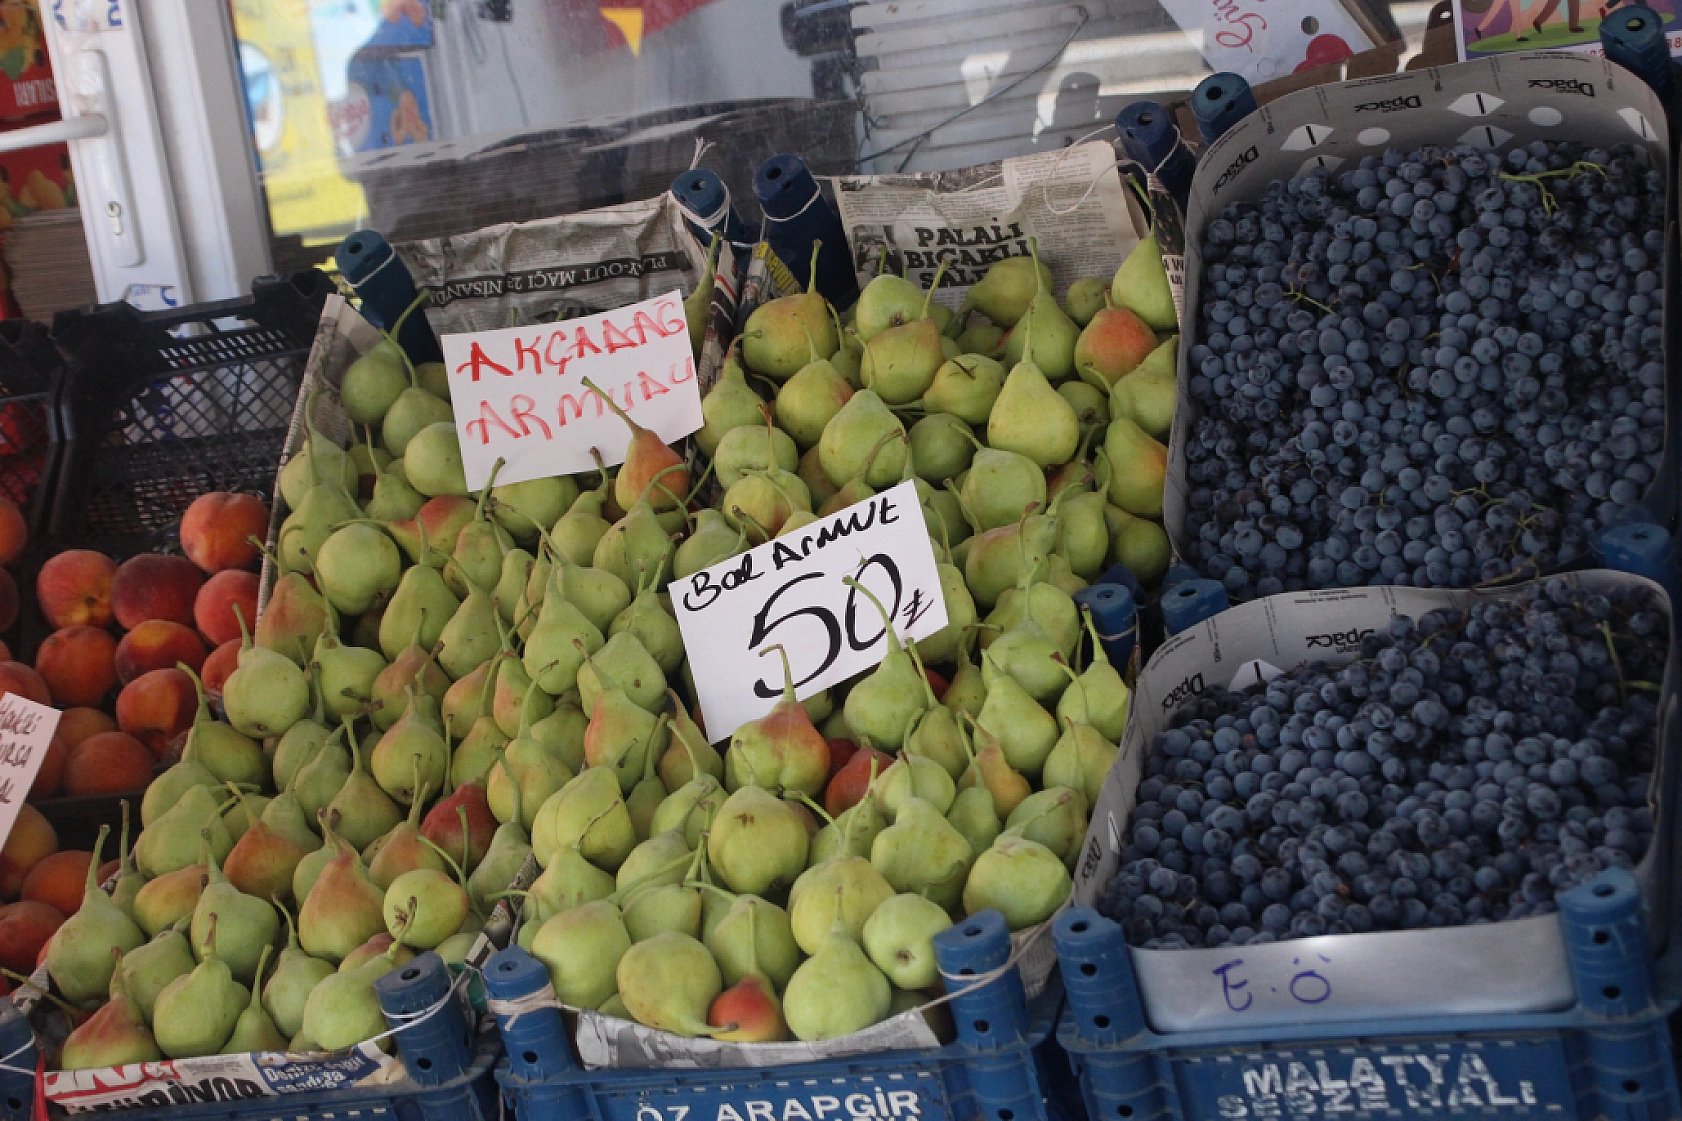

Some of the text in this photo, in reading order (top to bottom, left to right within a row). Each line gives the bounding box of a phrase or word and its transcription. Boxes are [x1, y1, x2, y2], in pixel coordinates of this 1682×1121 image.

[1212, 0, 1268, 53] Gü
[456, 299, 686, 382] AKÇADAĞ
[465, 356, 695, 445] ARMUDU
[1243, 1052, 1492, 1098] MALATYA
[716, 1086, 921, 1121] ARAPGİR
[1217, 1086, 1391, 1119] SEBZE
